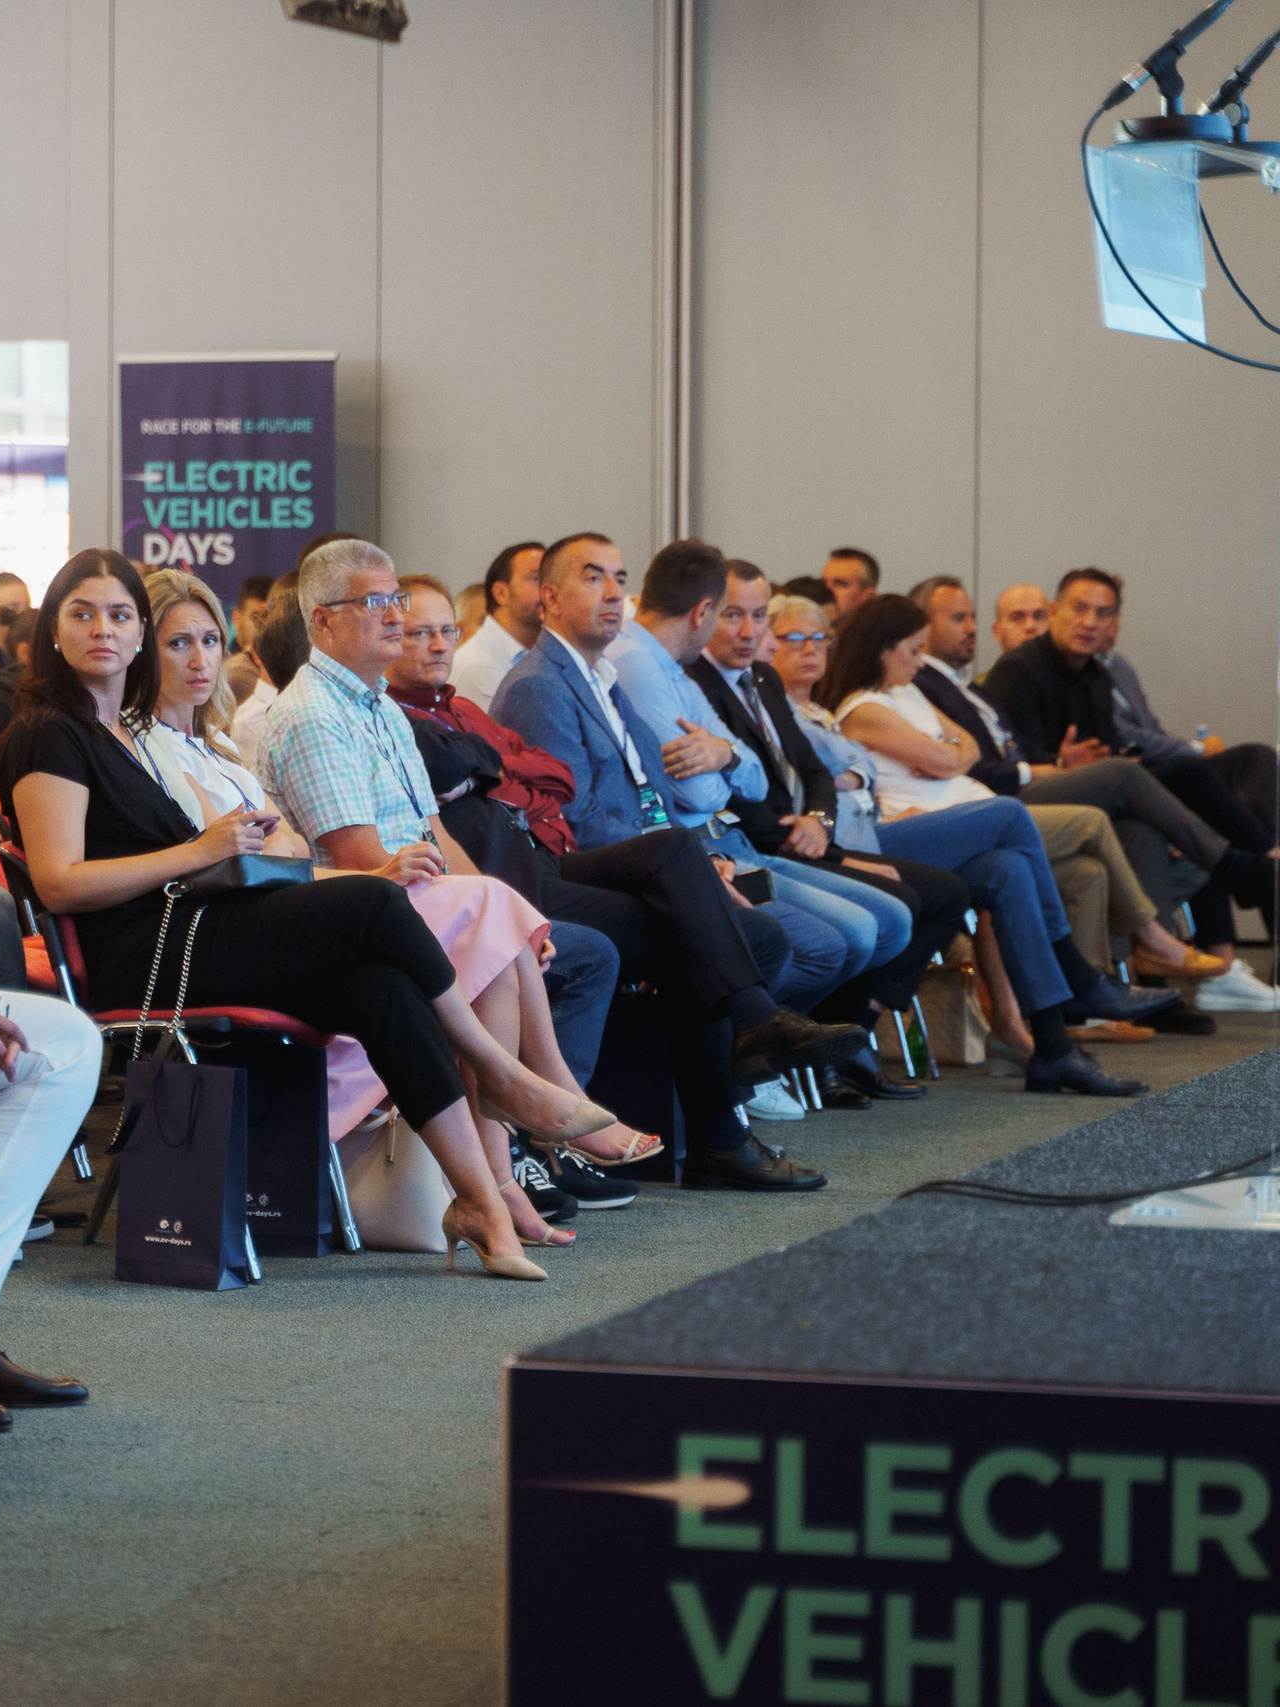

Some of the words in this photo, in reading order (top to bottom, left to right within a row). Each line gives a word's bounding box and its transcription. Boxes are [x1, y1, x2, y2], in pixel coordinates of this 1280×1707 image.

[140, 418, 180, 435] RACE
[181, 418, 213, 435] FOR
[214, 418, 242, 435] THE
[144, 460, 313, 493] ELECTRIC
[143, 497, 315, 529] VEHICLES
[143, 533, 236, 565] DAYS
[145, 1235, 192, 1246] www.ev-days.rs
